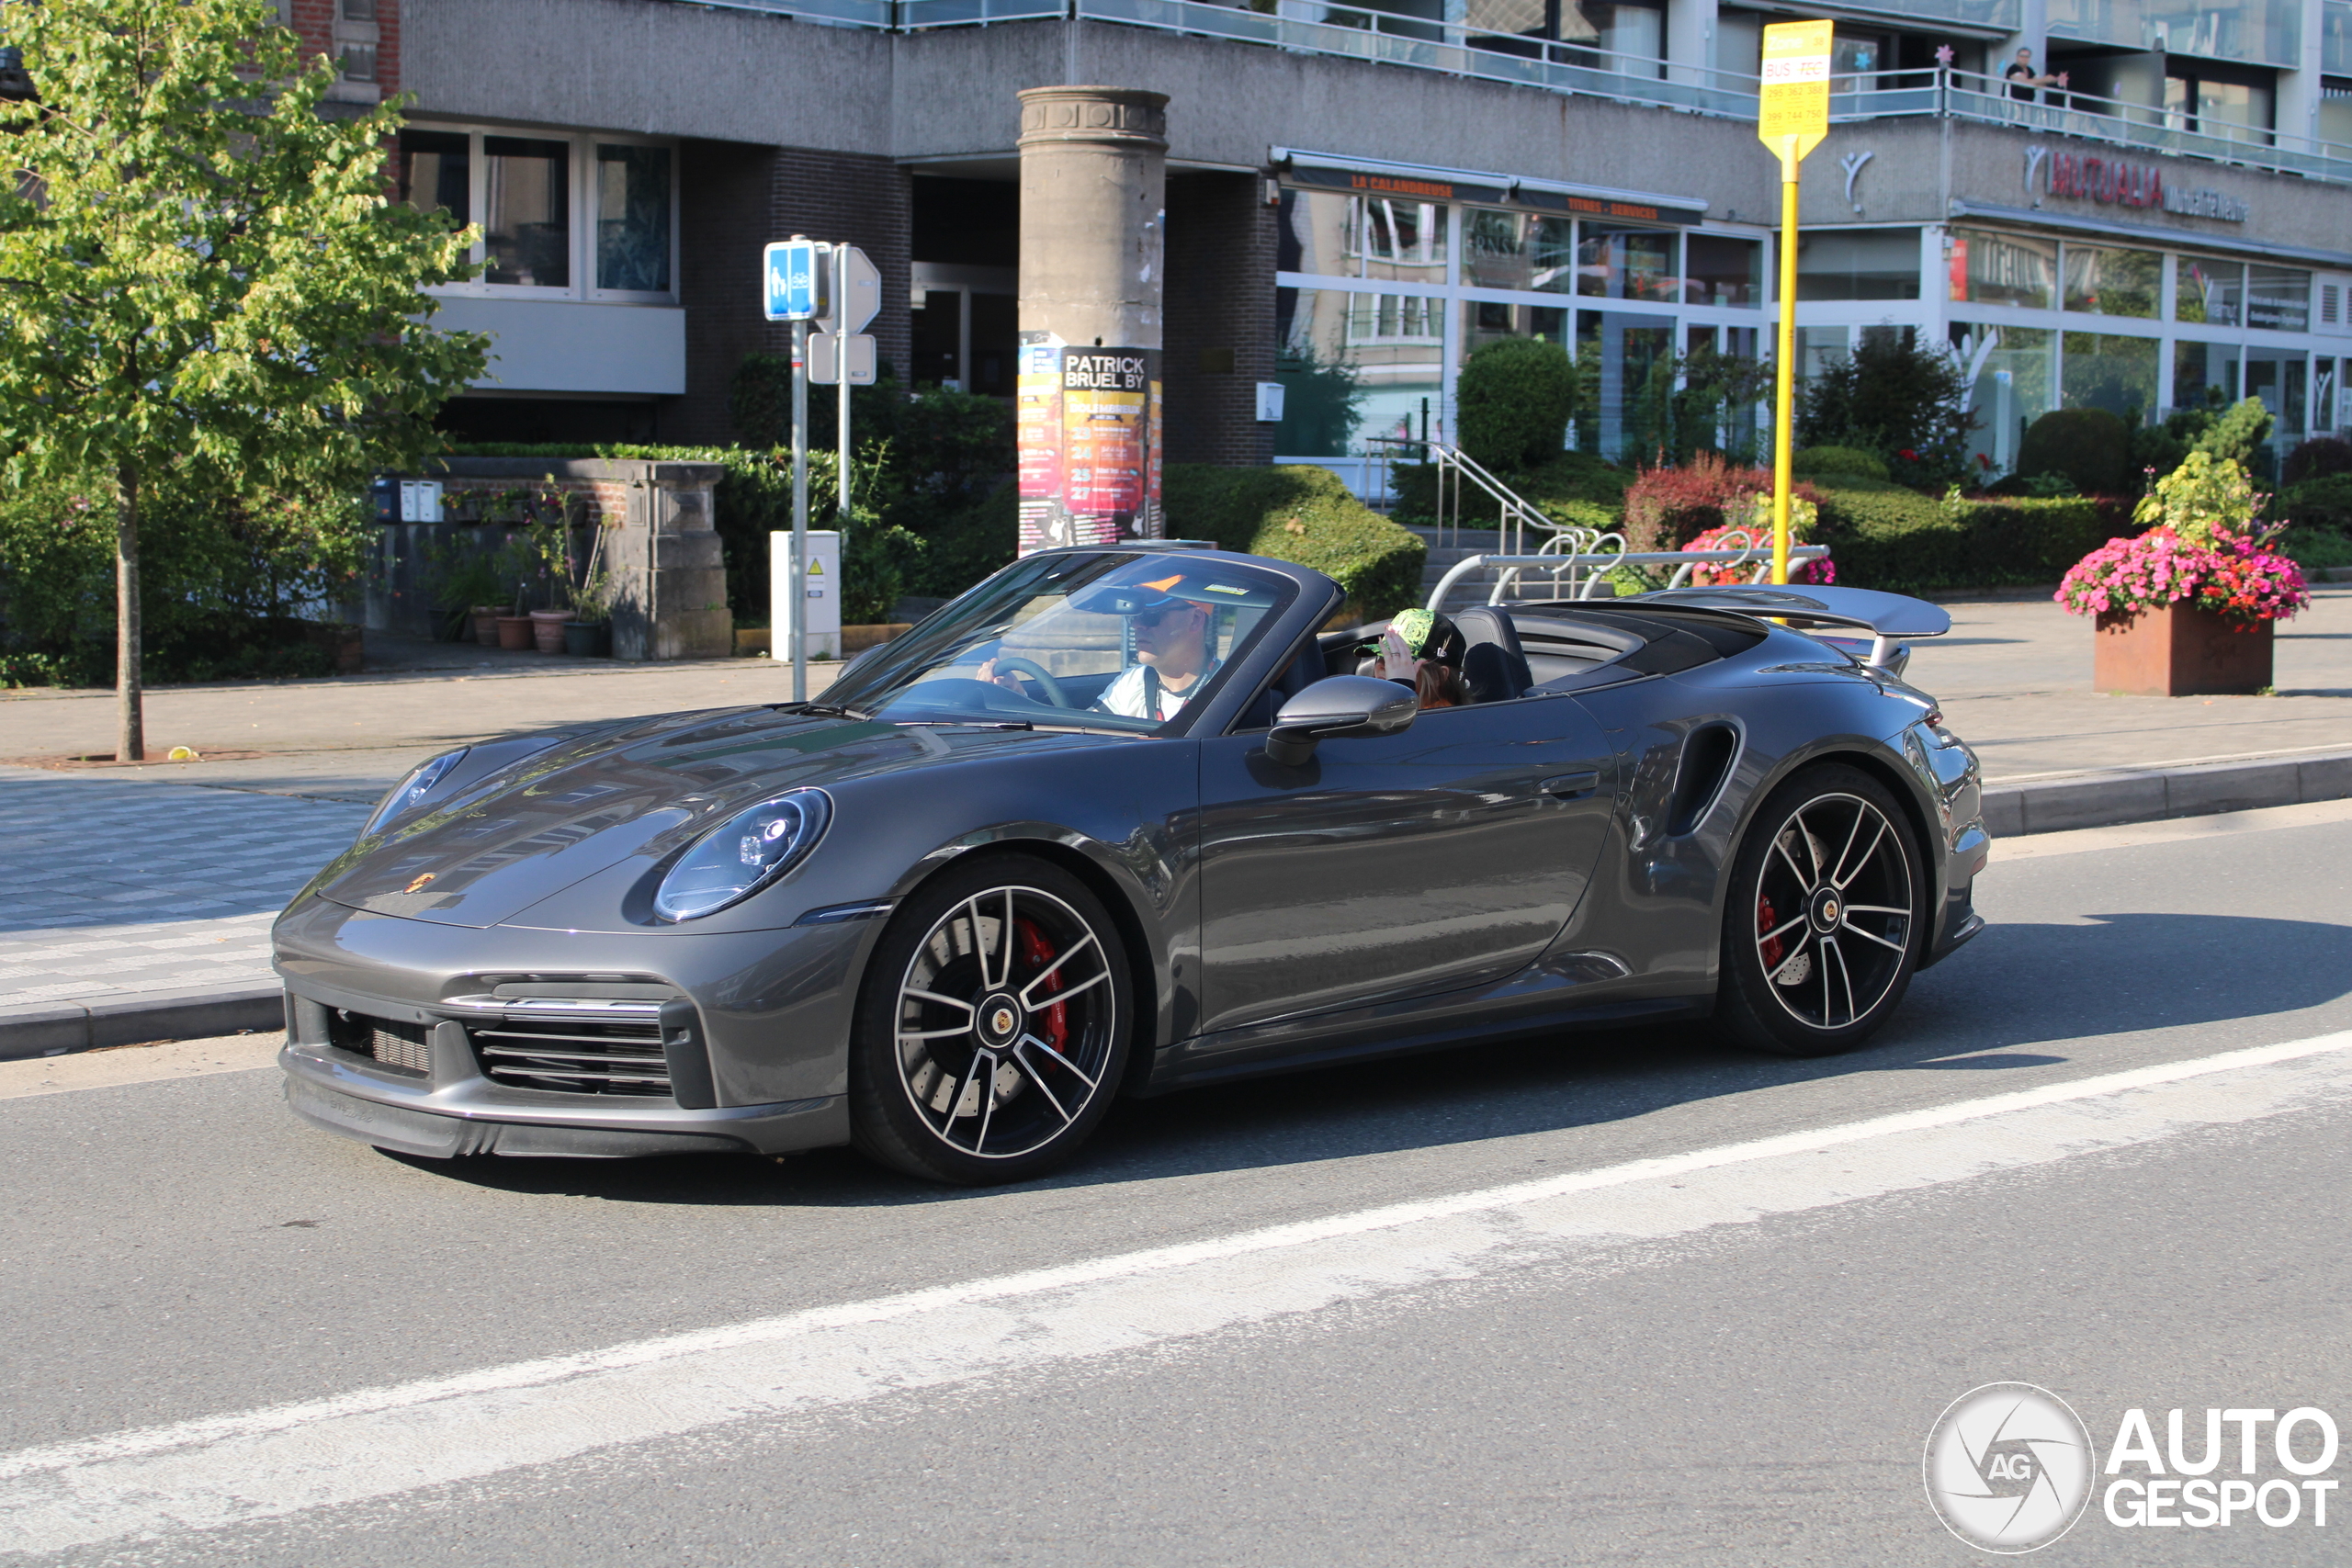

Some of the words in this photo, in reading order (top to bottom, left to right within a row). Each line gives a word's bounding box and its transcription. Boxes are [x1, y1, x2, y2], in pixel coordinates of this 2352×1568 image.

[1767, 36, 1803, 51] Zone
[1814, 37, 1825, 46] 38
[1766, 62, 1790, 77] BUS
[1800, 61, 1823, 75] TEC
[1768, 88, 1783, 97] 295
[1788, 86, 1803, 96] 362
[1806, 85, 1823, 96] 388
[1767, 112, 1782, 121] 399
[1787, 111, 1803, 119] 744
[1806, 108, 1822, 118] 750
[1351, 175, 1367, 188] LA
[1371, 176, 1453, 198] CALANDREUSE
[2050, 152, 2163, 208] MUTUALIA
[1567, 197, 1602, 213] TITRES
[1611, 202, 1658, 220] SERVICES
[1066, 355, 1145, 374] PATRICK
[1066, 371, 1123, 388] BRUEL
[1125, 374, 1145, 389] BY
[1069, 403, 1141, 415] DOLEMBREUX
[1071, 426, 1091, 439] 23
[1071, 446, 1091, 459] 24
[1071, 468, 1091, 481] 25
[1071, 487, 1091, 500] 27
